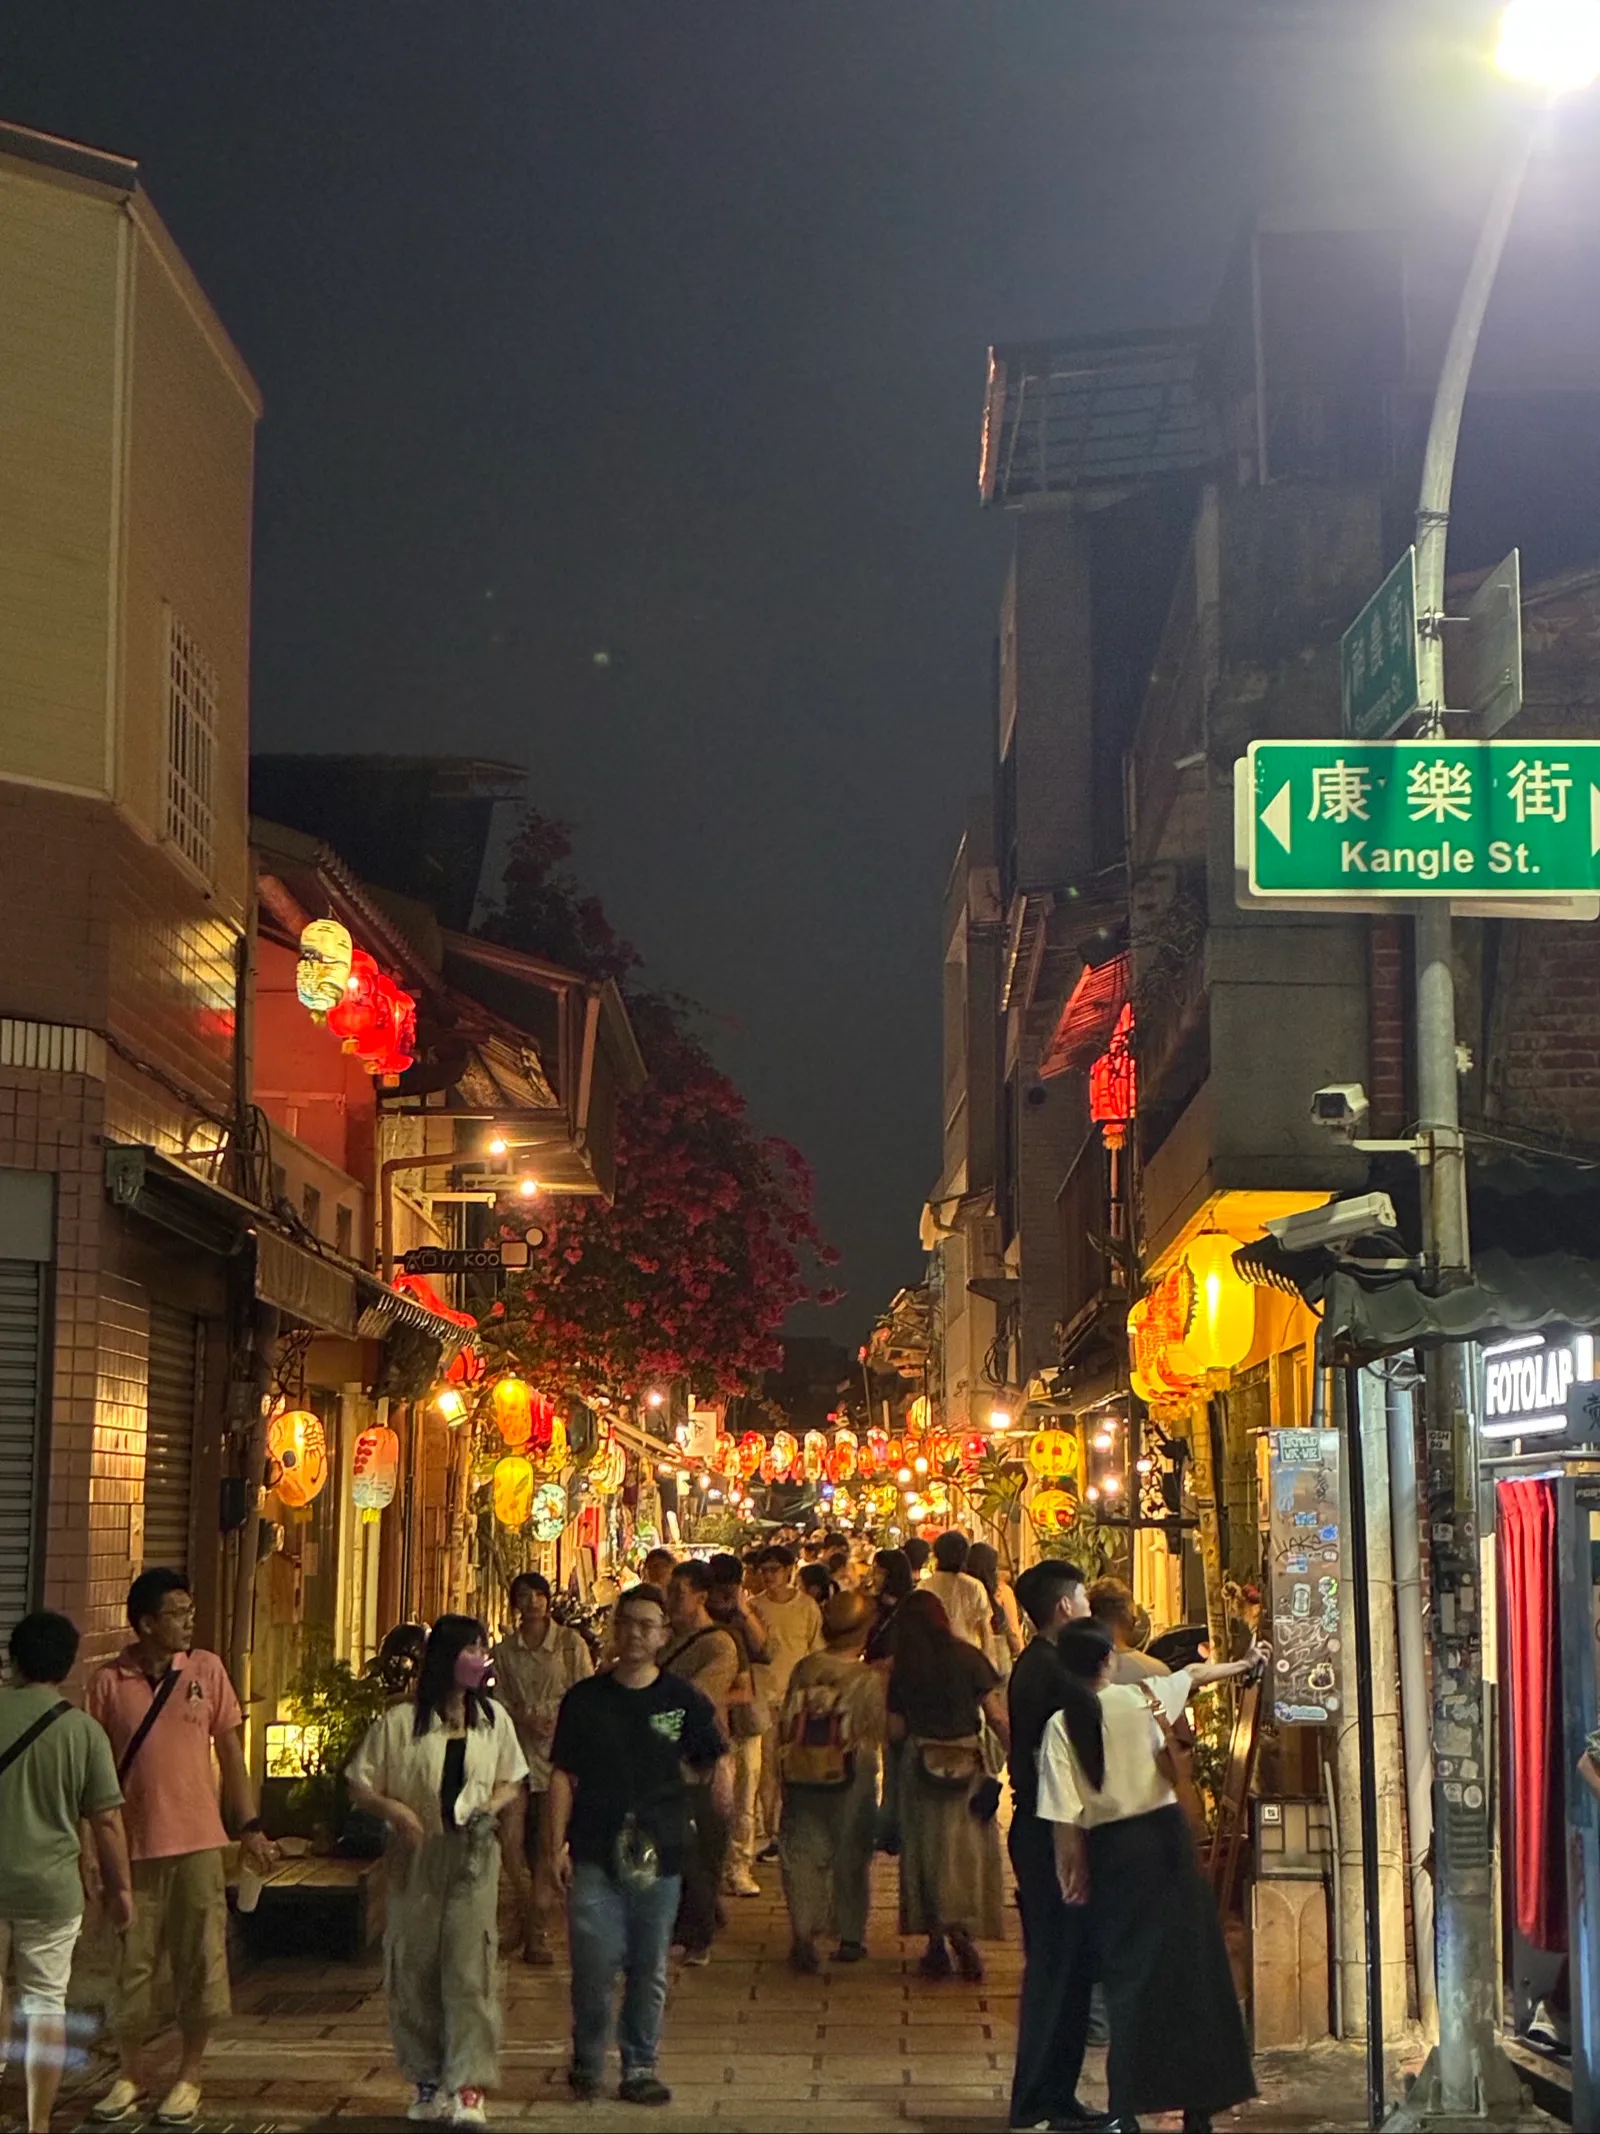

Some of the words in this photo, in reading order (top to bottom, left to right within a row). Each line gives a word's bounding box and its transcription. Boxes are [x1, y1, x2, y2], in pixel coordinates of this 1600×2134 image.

[1308, 759, 1573, 823] 康樂街
[1341, 841, 1474, 880] Kangle
[1488, 841, 1541, 874] St.
